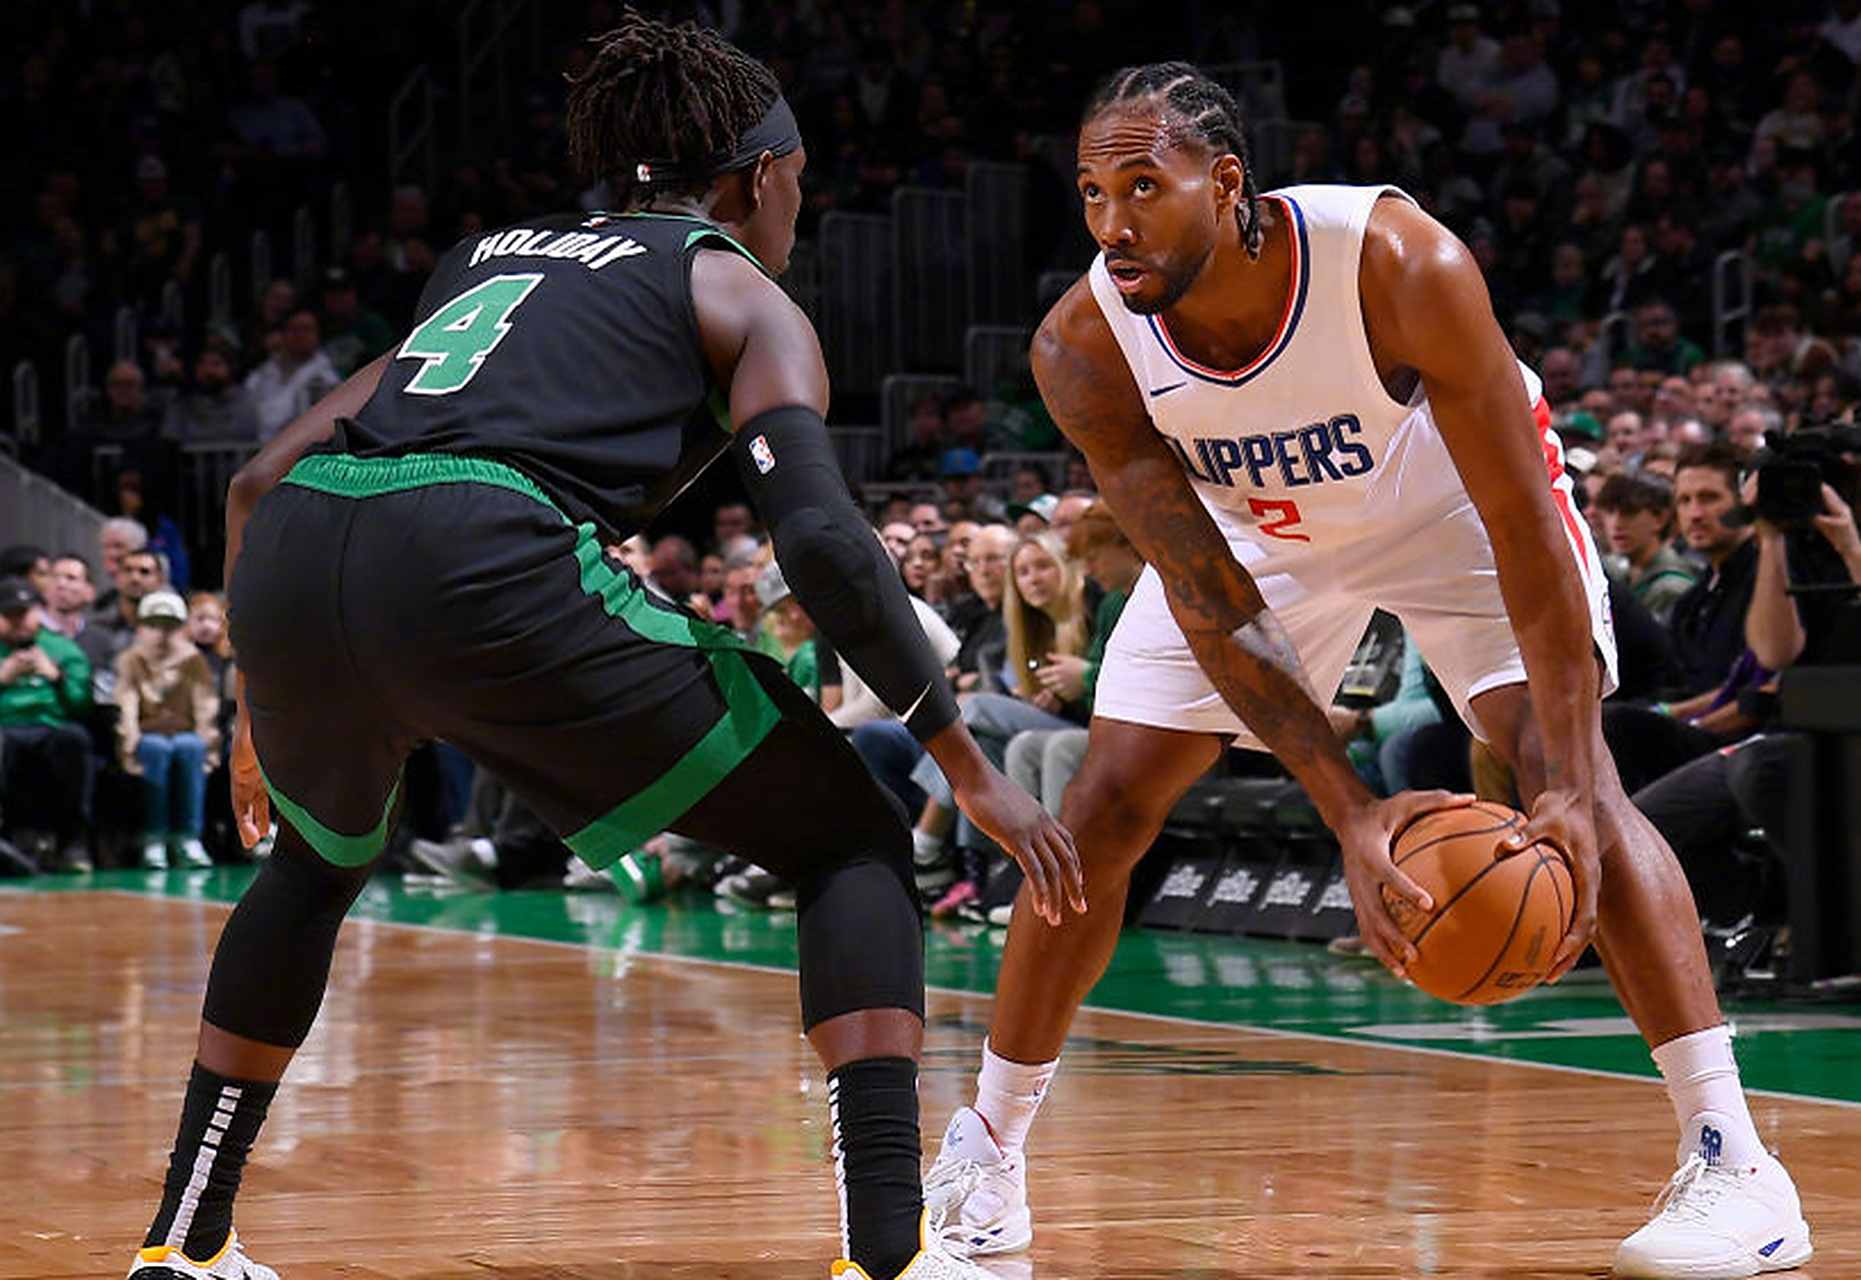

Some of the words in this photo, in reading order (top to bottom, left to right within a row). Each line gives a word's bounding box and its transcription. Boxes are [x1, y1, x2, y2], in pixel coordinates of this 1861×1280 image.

[468, 229, 648, 270] HOLIDAY
[396, 272, 546, 395] 4
[1163, 413, 1375, 487] LIPPERS
[1247, 498, 1311, 542] 2
